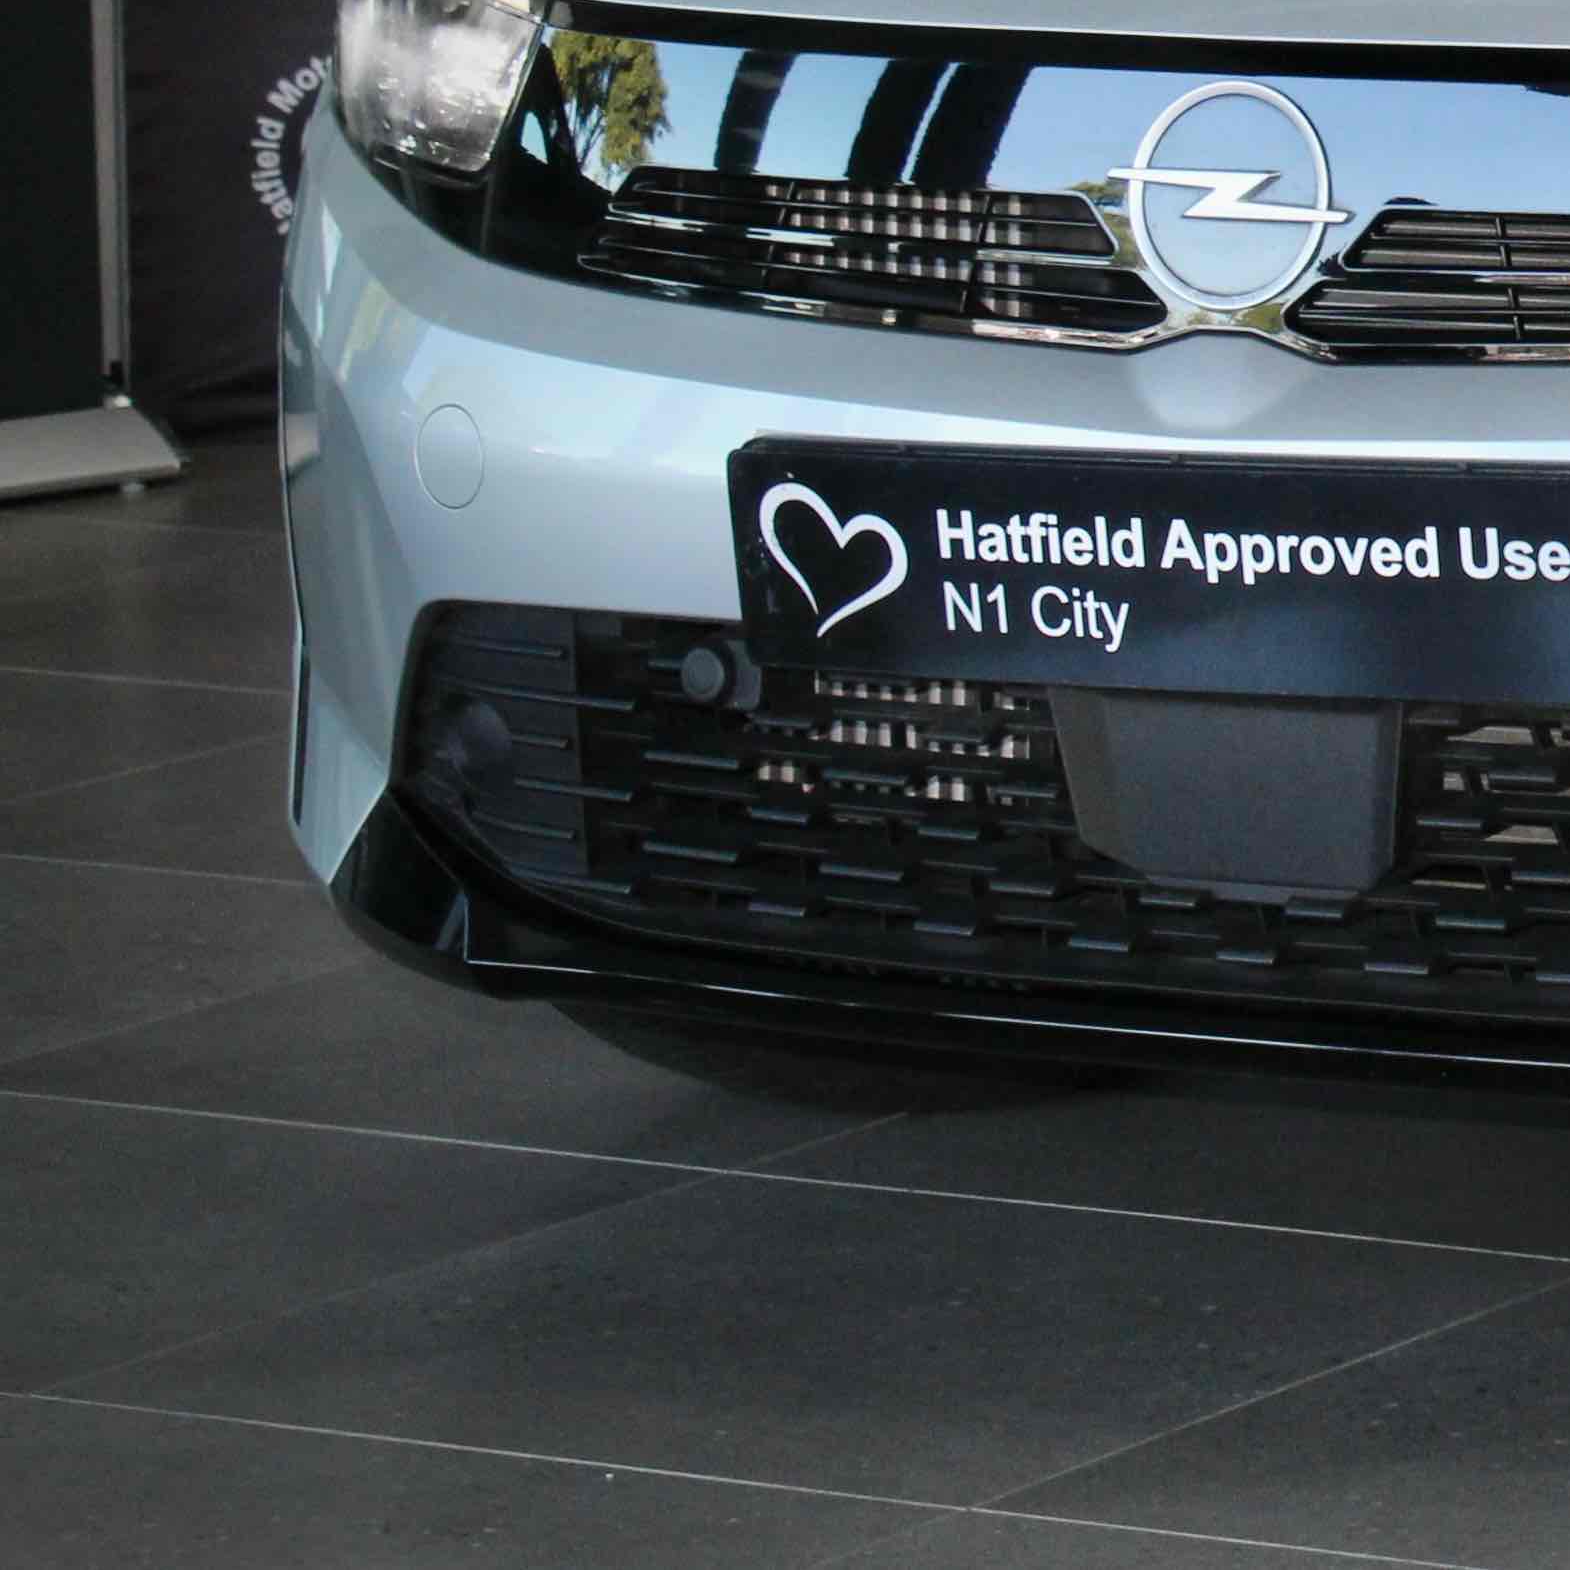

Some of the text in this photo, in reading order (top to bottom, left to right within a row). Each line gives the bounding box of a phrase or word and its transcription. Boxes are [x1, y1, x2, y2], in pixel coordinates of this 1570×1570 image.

[266, 55, 333, 116] Mot
[936, 508, 1146, 568] Hatfield
[1160, 518, 1440, 585] Approved
[943, 581, 1129, 653] N1 City
